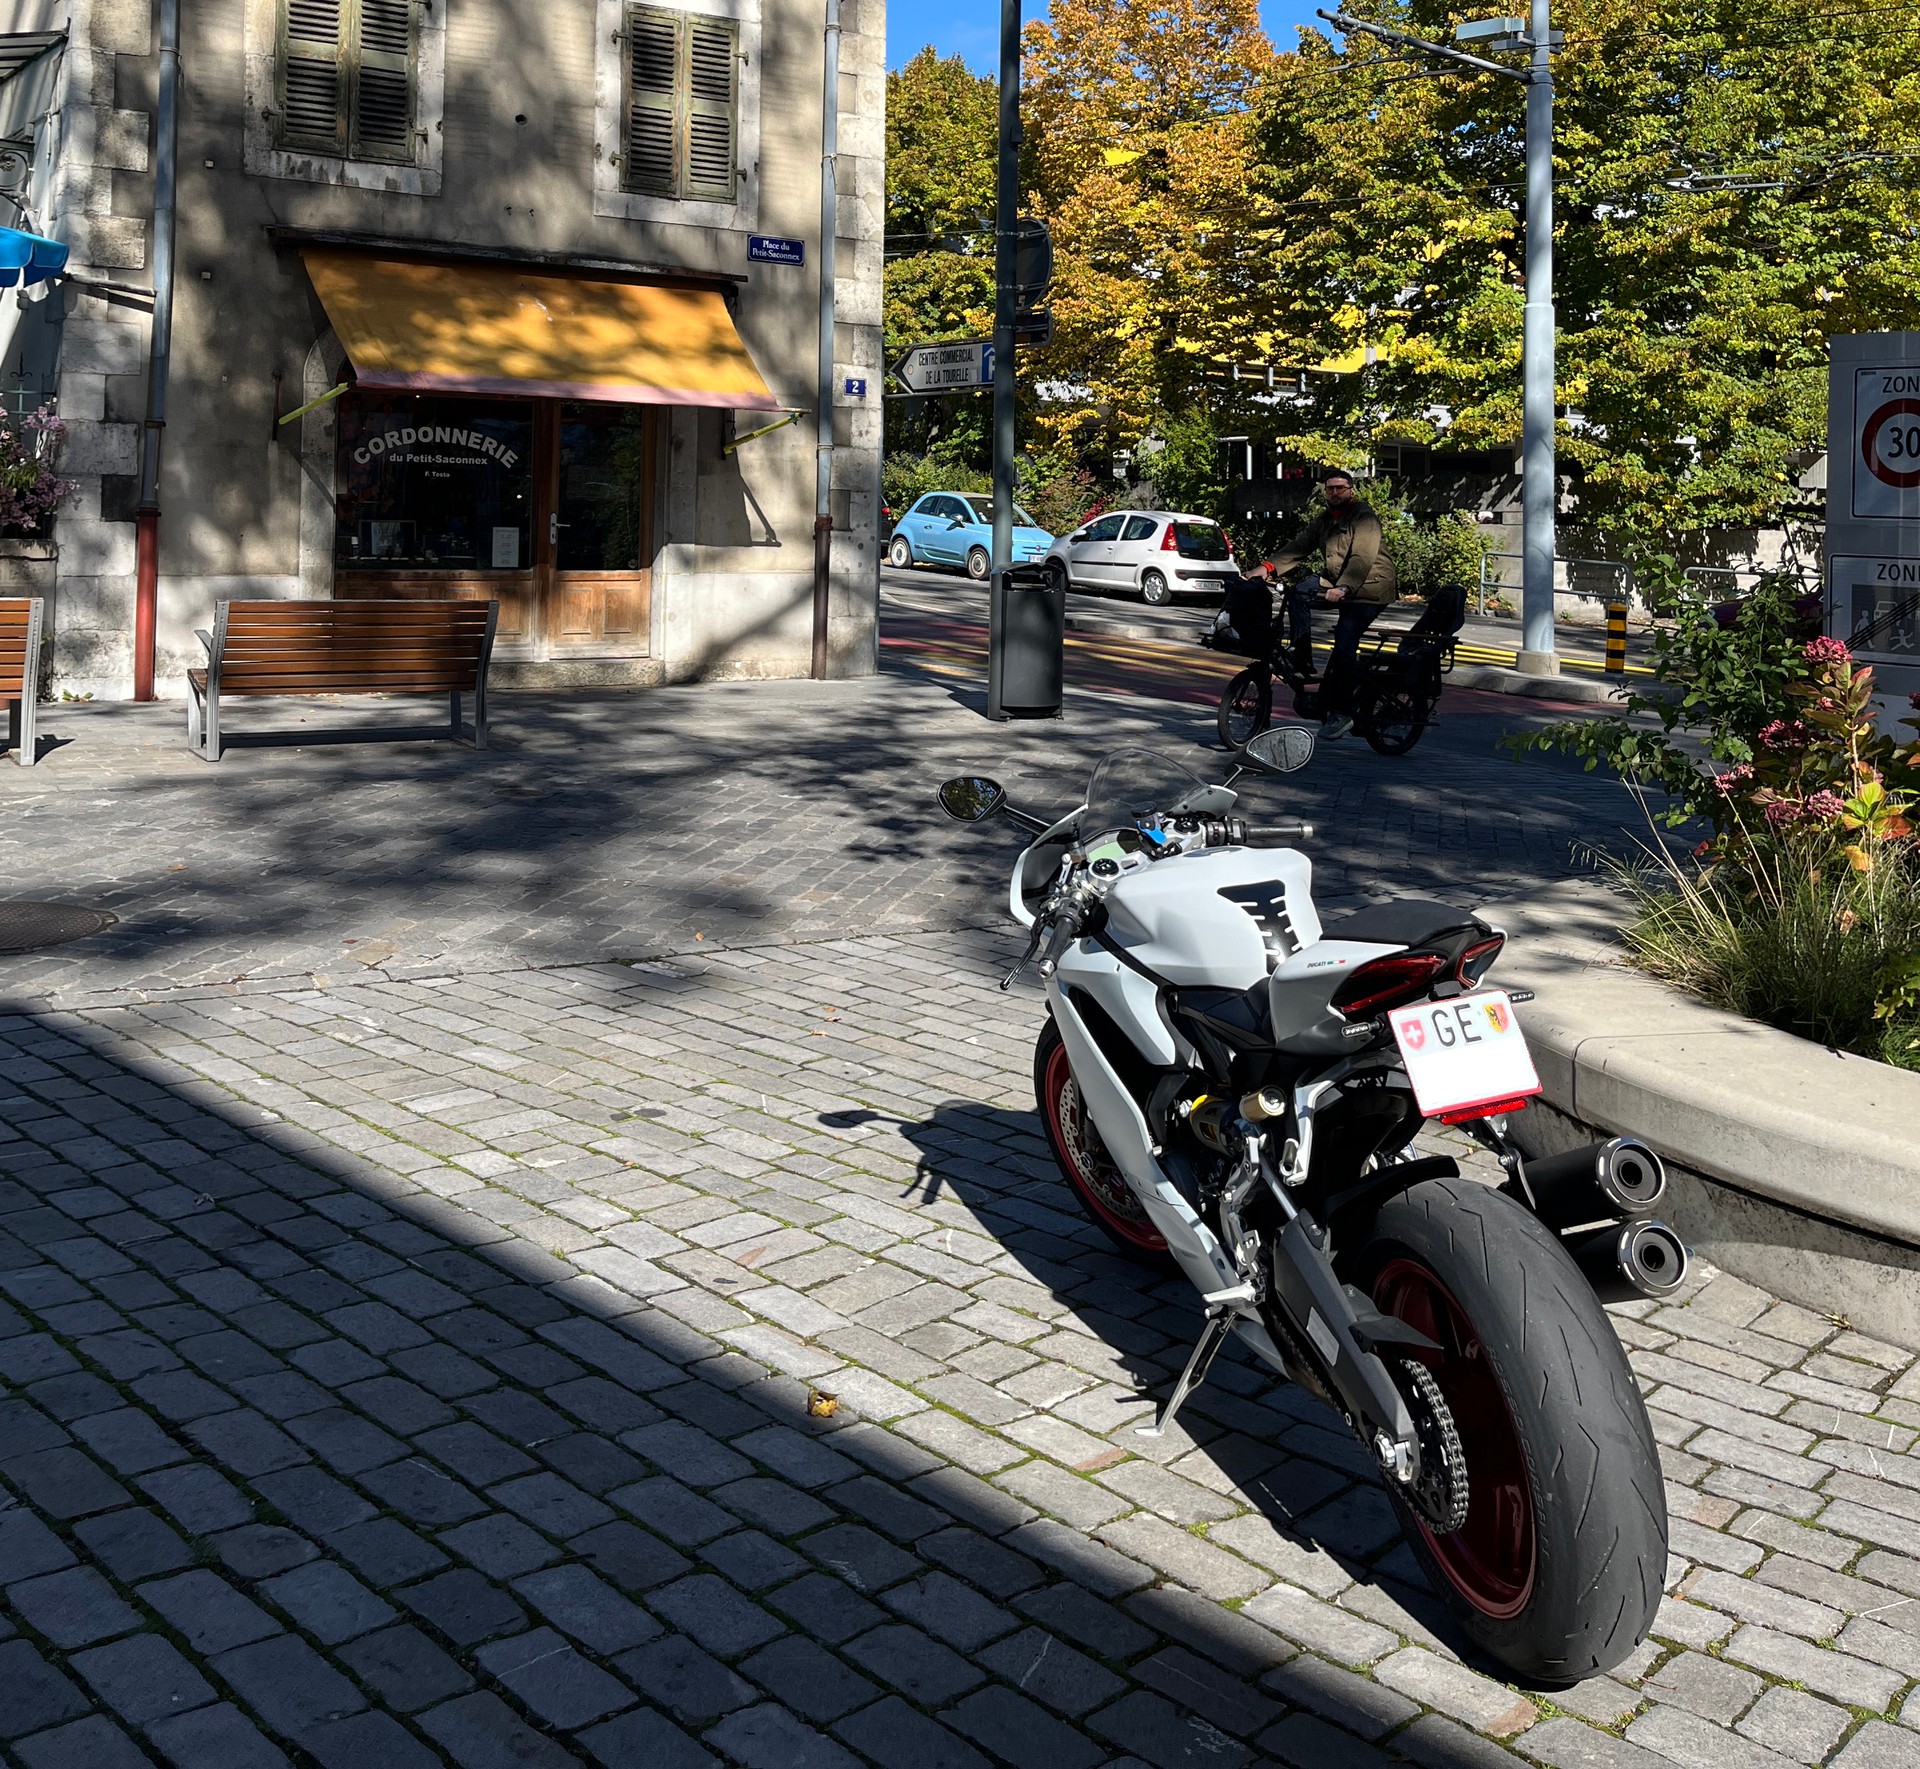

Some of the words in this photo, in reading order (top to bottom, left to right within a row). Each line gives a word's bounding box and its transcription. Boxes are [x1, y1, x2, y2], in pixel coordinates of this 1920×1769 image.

[762, 240, 780, 250] Place
[780, 242, 790, 251] du
[918, 351, 938, 366] CENTRE
[939, 348, 974, 365] COMMERCIAL
[925, 370, 933, 385] DE
[933, 369, 941, 384] LA
[942, 367, 969, 384] TOURELLE
[851, 380, 859, 393] 2
[353, 426, 519, 469] CORDONNERIE
[1887, 426, 1920, 459] 30
[389, 453, 403, 463] du
[406, 453, 488, 465] Petit-Saconnex
[1877, 563, 1920, 582] ZON
[1306, 961, 1327, 969] DUCATI
[1430, 1003, 1482, 1048] GE
